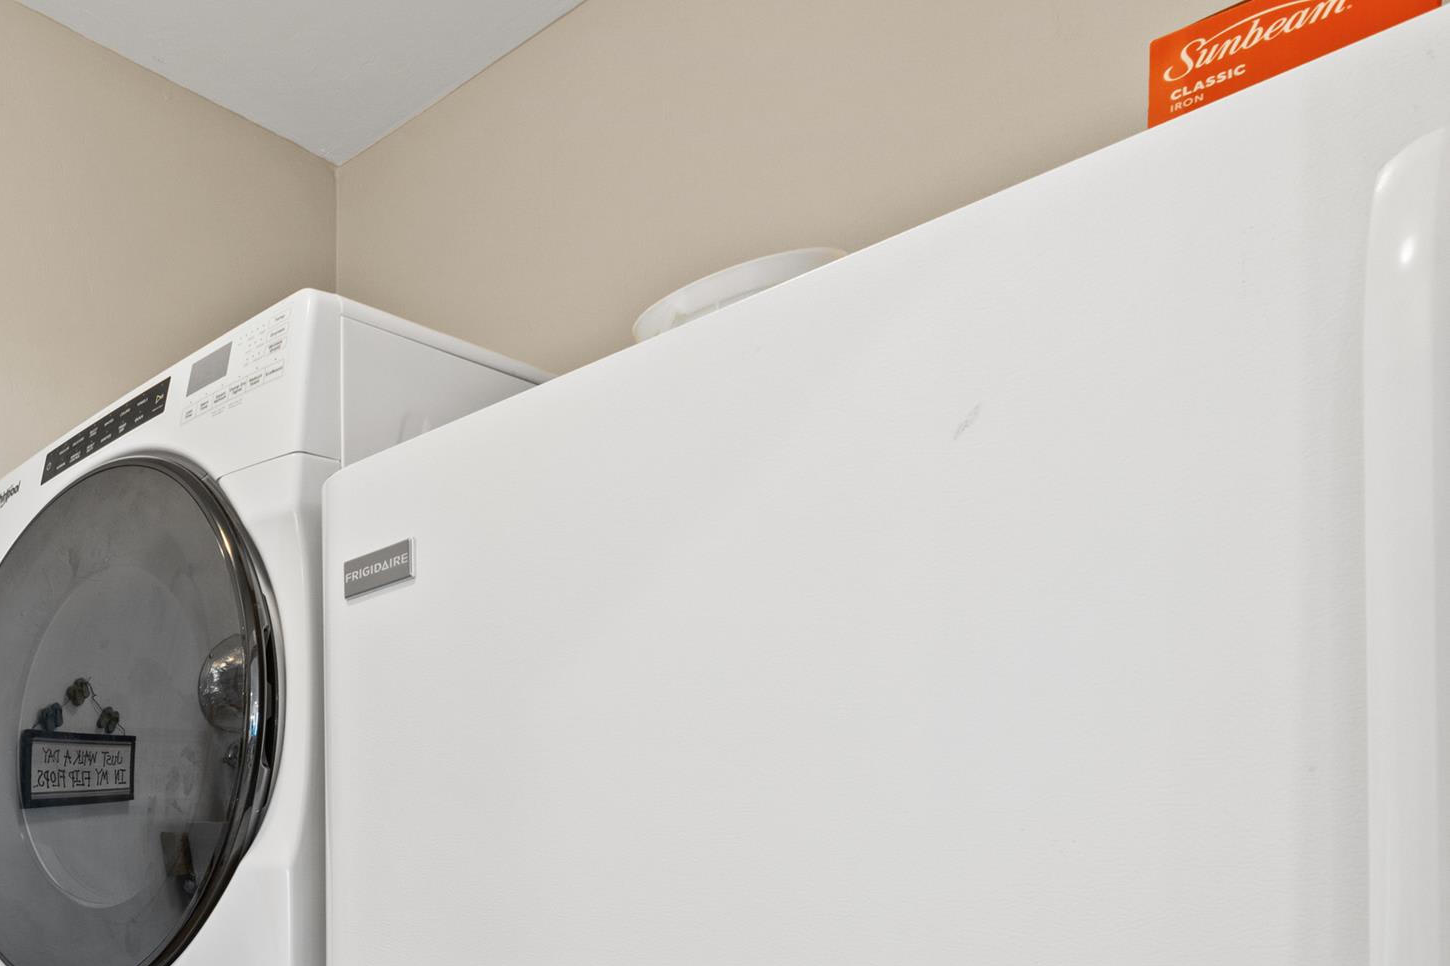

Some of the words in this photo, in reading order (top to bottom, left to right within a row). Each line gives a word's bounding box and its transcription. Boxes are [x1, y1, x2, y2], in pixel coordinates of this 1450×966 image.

[1163, 0, 1346, 82] Sunbeam
[1170, 64, 1246, 100] CLASSIC
[1170, 93, 1205, 113] IRON
[345, 552, 409, 583] FRIGIDAIRE
